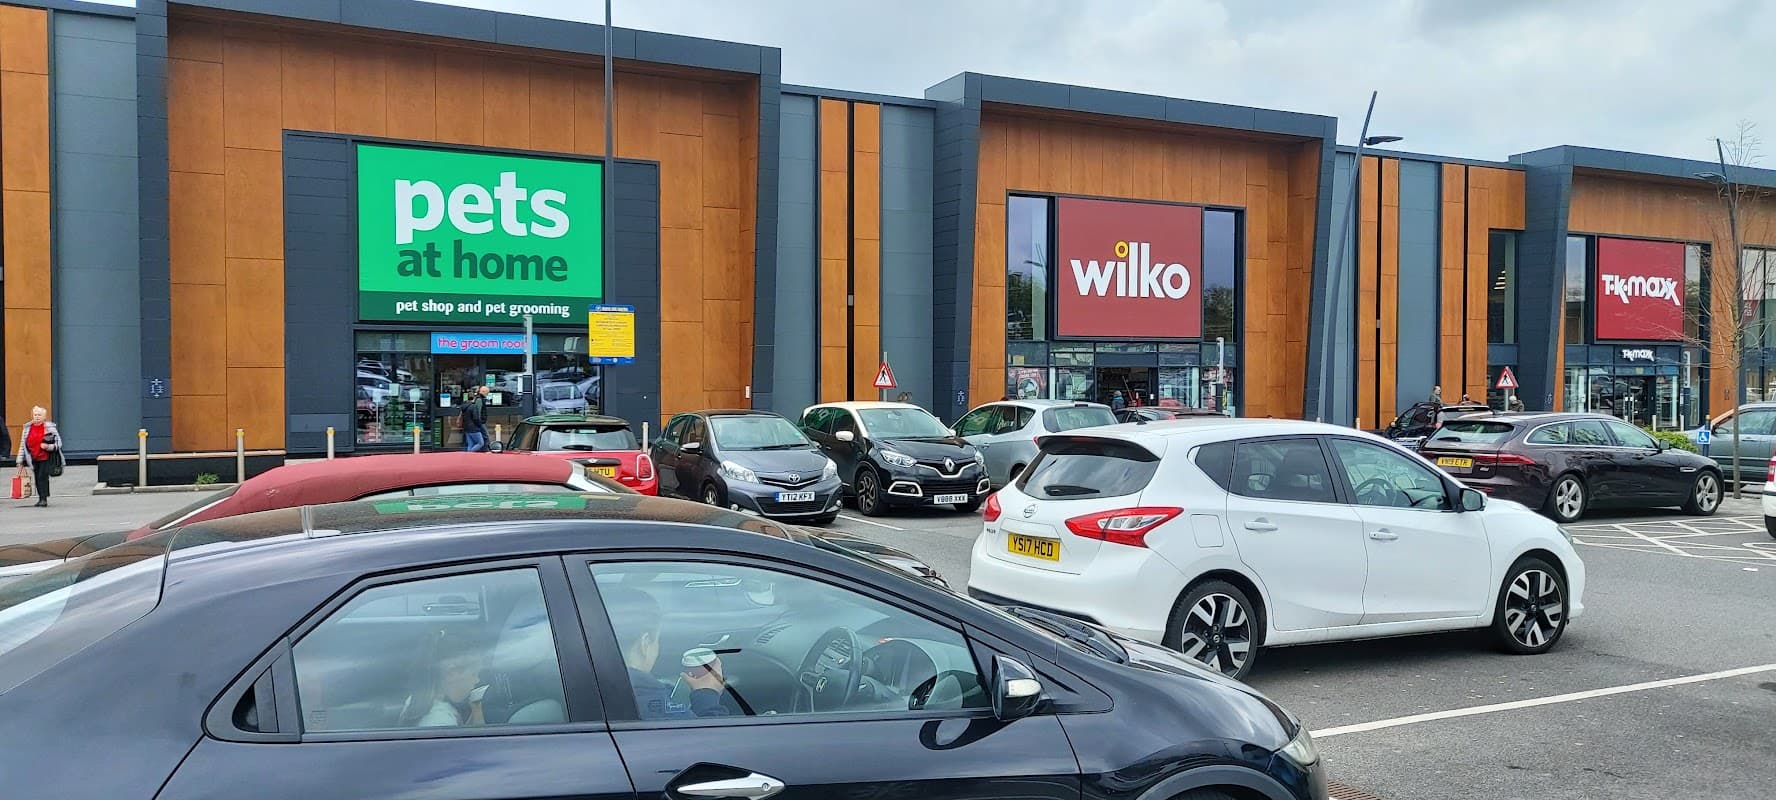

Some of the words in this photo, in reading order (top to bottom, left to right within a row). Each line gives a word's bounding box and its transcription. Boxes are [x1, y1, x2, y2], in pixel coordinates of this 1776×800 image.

[395, 171, 570, 245] pets
[397, 242, 442, 278] at
[453, 239, 568, 282] home
[1070, 240, 1191, 300] wilko
[395, 300, 418, 314] pet
[421, 299, 454, 315] shop
[457, 300, 482, 313] and
[485, 302, 506, 316] pet
[509, 303, 571, 318] grooming
[438, 337, 458, 348] the
[460, 339, 499, 351] groom
[501, 340, 527, 350] roo
[1013, 536, 1032, 553] YS17
[1034, 541, 1054, 557] HCD
